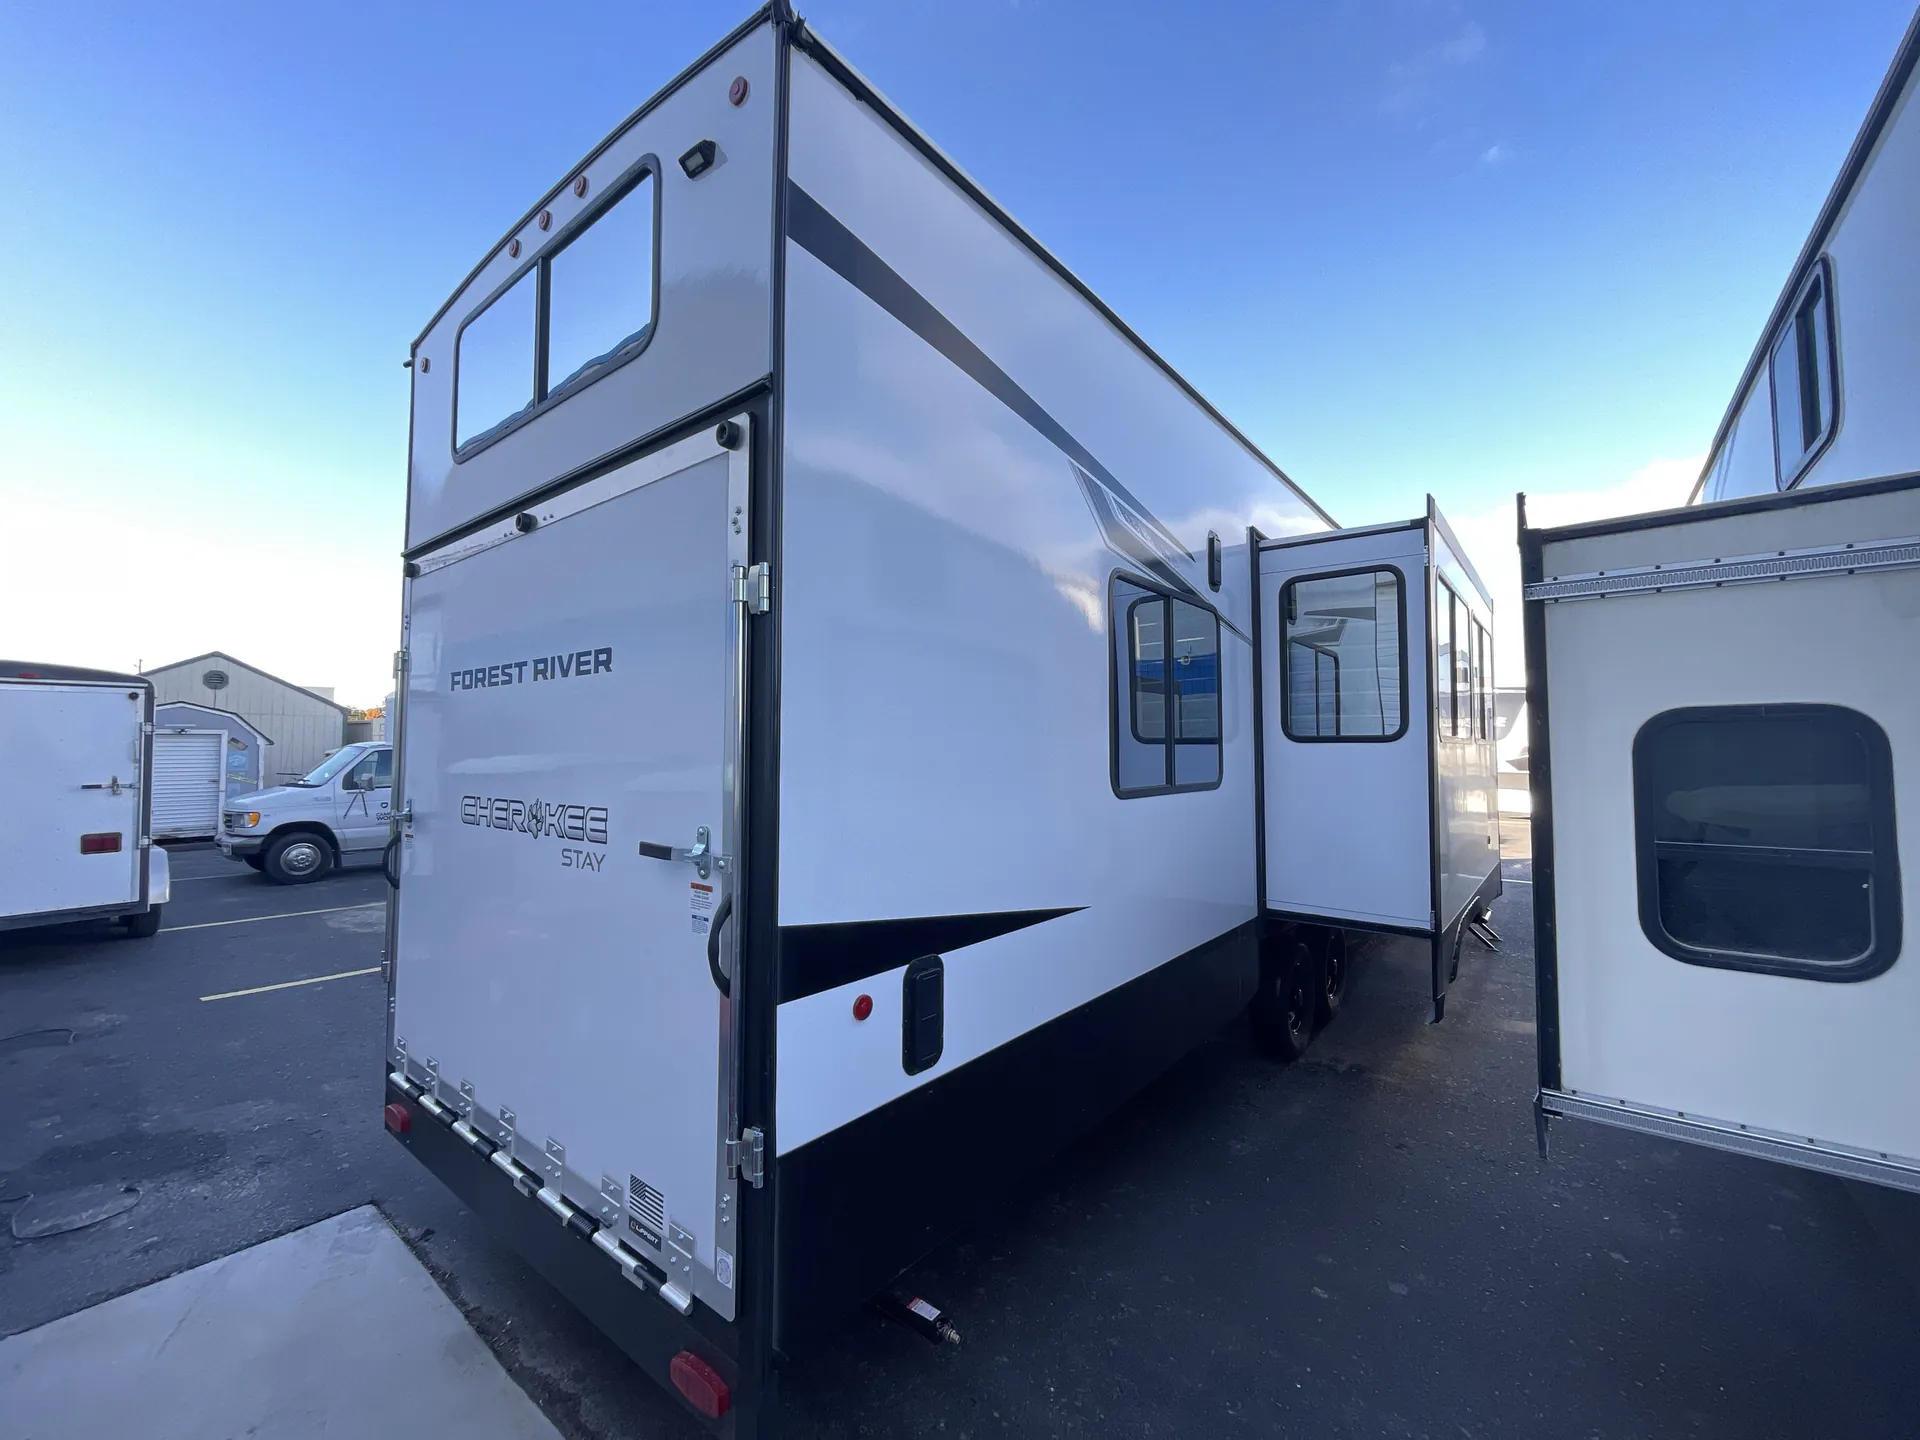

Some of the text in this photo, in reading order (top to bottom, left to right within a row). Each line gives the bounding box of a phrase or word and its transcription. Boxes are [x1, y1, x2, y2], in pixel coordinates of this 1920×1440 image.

[450, 647, 613, 691] FOREST RIVER
[461, 796, 609, 844] CHEROKEE
[561, 848, 606, 872] STAY
